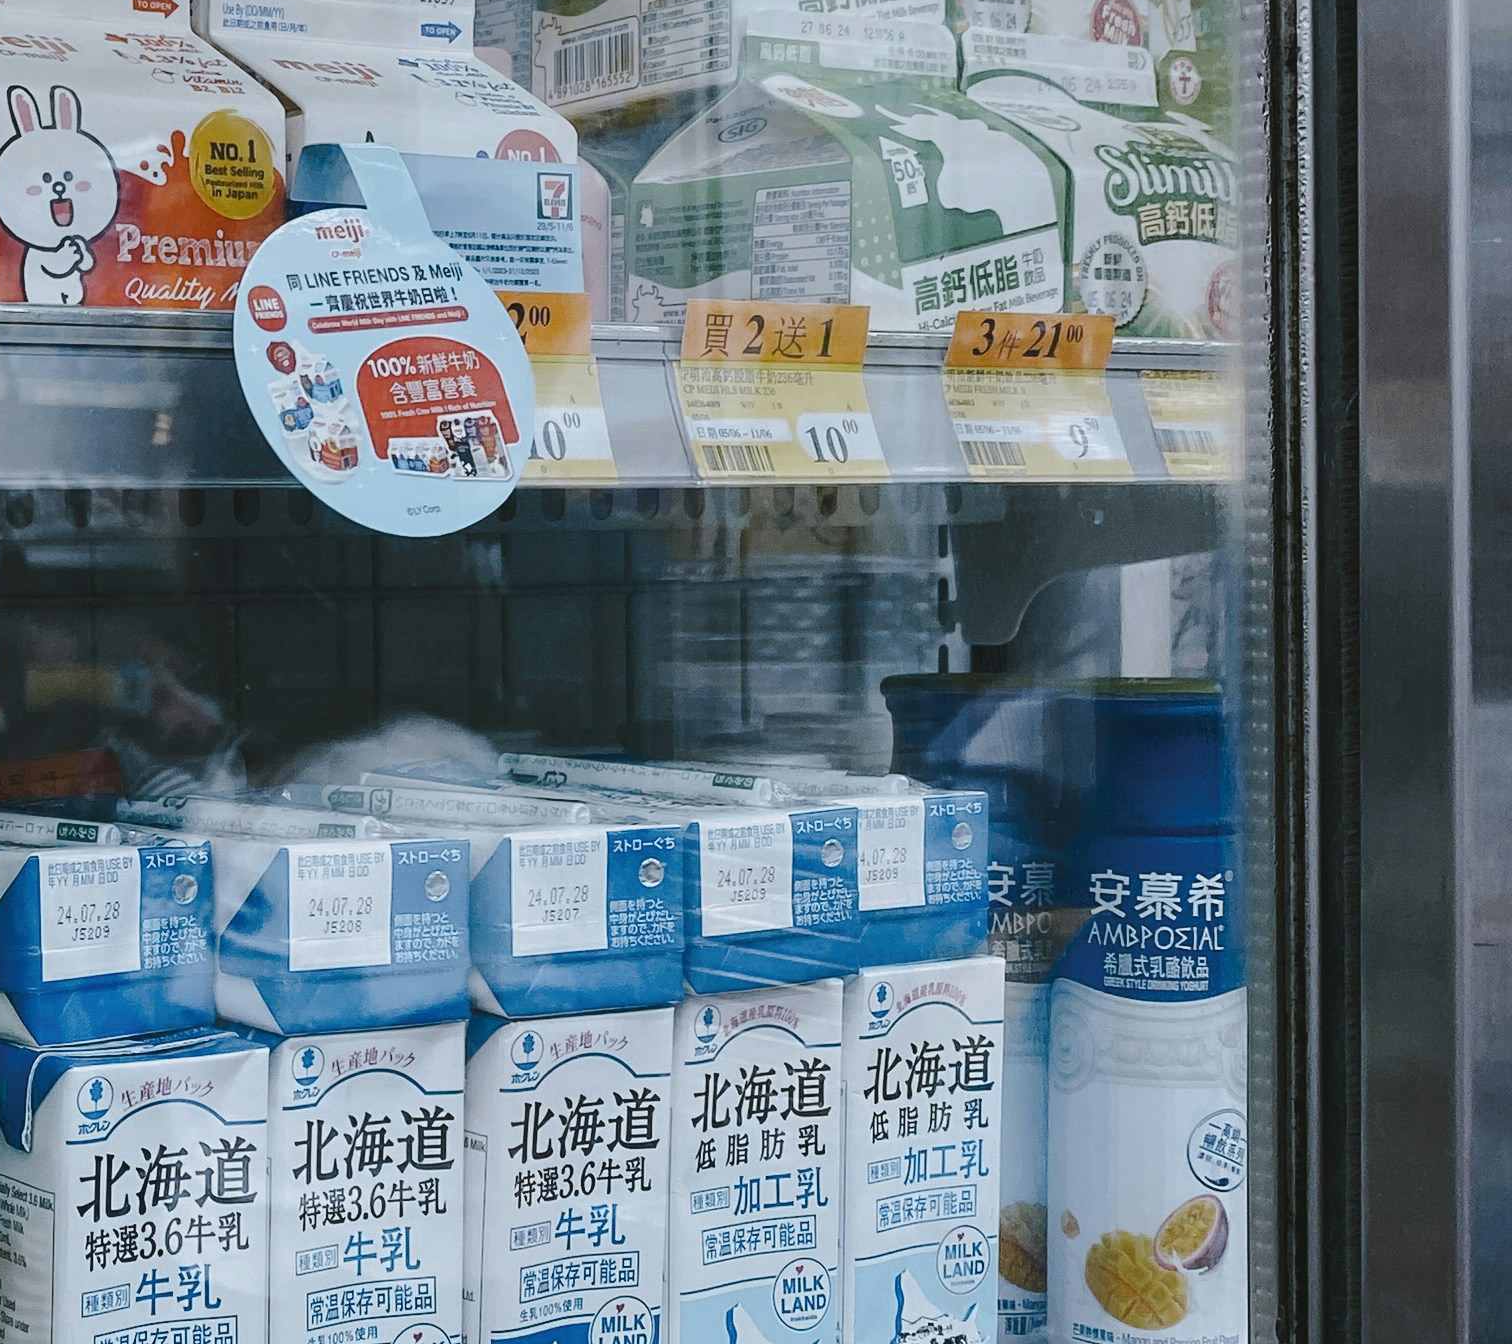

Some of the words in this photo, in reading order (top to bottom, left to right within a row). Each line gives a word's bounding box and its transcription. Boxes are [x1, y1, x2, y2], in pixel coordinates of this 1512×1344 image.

[204, 165, 231, 177] Best
[233, 166, 264, 181] Selling
[223, 188, 258, 202] Japan
[305, 269, 340, 290] LINE
[343, 265, 410, 287] FRIENDS
[430, 261, 464, 281] Meiji
[911, 252, 1022, 317] 高鈣低脂
[252, 296, 280, 313] LINE
[700, 313, 734, 357] 買
[742, 315, 765, 354] 2
[772, 317, 807, 359] 送
[816, 318, 834, 357] 1
[398, 848, 462, 865] ストローぐち
[612, 834, 676, 852] ストローぐち
[56, 901, 121, 925] 24.07.28
[1088, 868, 1225, 922] 安慕希
[863, 1035, 997, 1103] 北海道
[690, 1057, 833, 1133] 北海道
[292, 1106, 456, 1185] 北海道
[506, 1087, 662, 1164] 北海道
[77, 1136, 259, 1222] 北海道
[513, 1157, 652, 1208] 特選3.6牛乳
[903, 1139, 990, 1184] 加工乳
[299, 1178, 448, 1231] 特選3.6牛乳
[733, 1175, 829, 1216] 加工乳
[85, 1211, 250, 1271] 特選3.6牛乳
[555, 1204, 626, 1251] 牛乳
[942, 1260, 986, 1277] LAND
[943, 1242, 984, 1260] MILK
[520, 1254, 638, 1298] 常温保存可能品
[782, 1276, 826, 1297] MILK
[308, 1282, 434, 1325] 常温保存可能品
[600, 1313, 648, 1334] MILK
[779, 1294, 827, 1316] LAND
